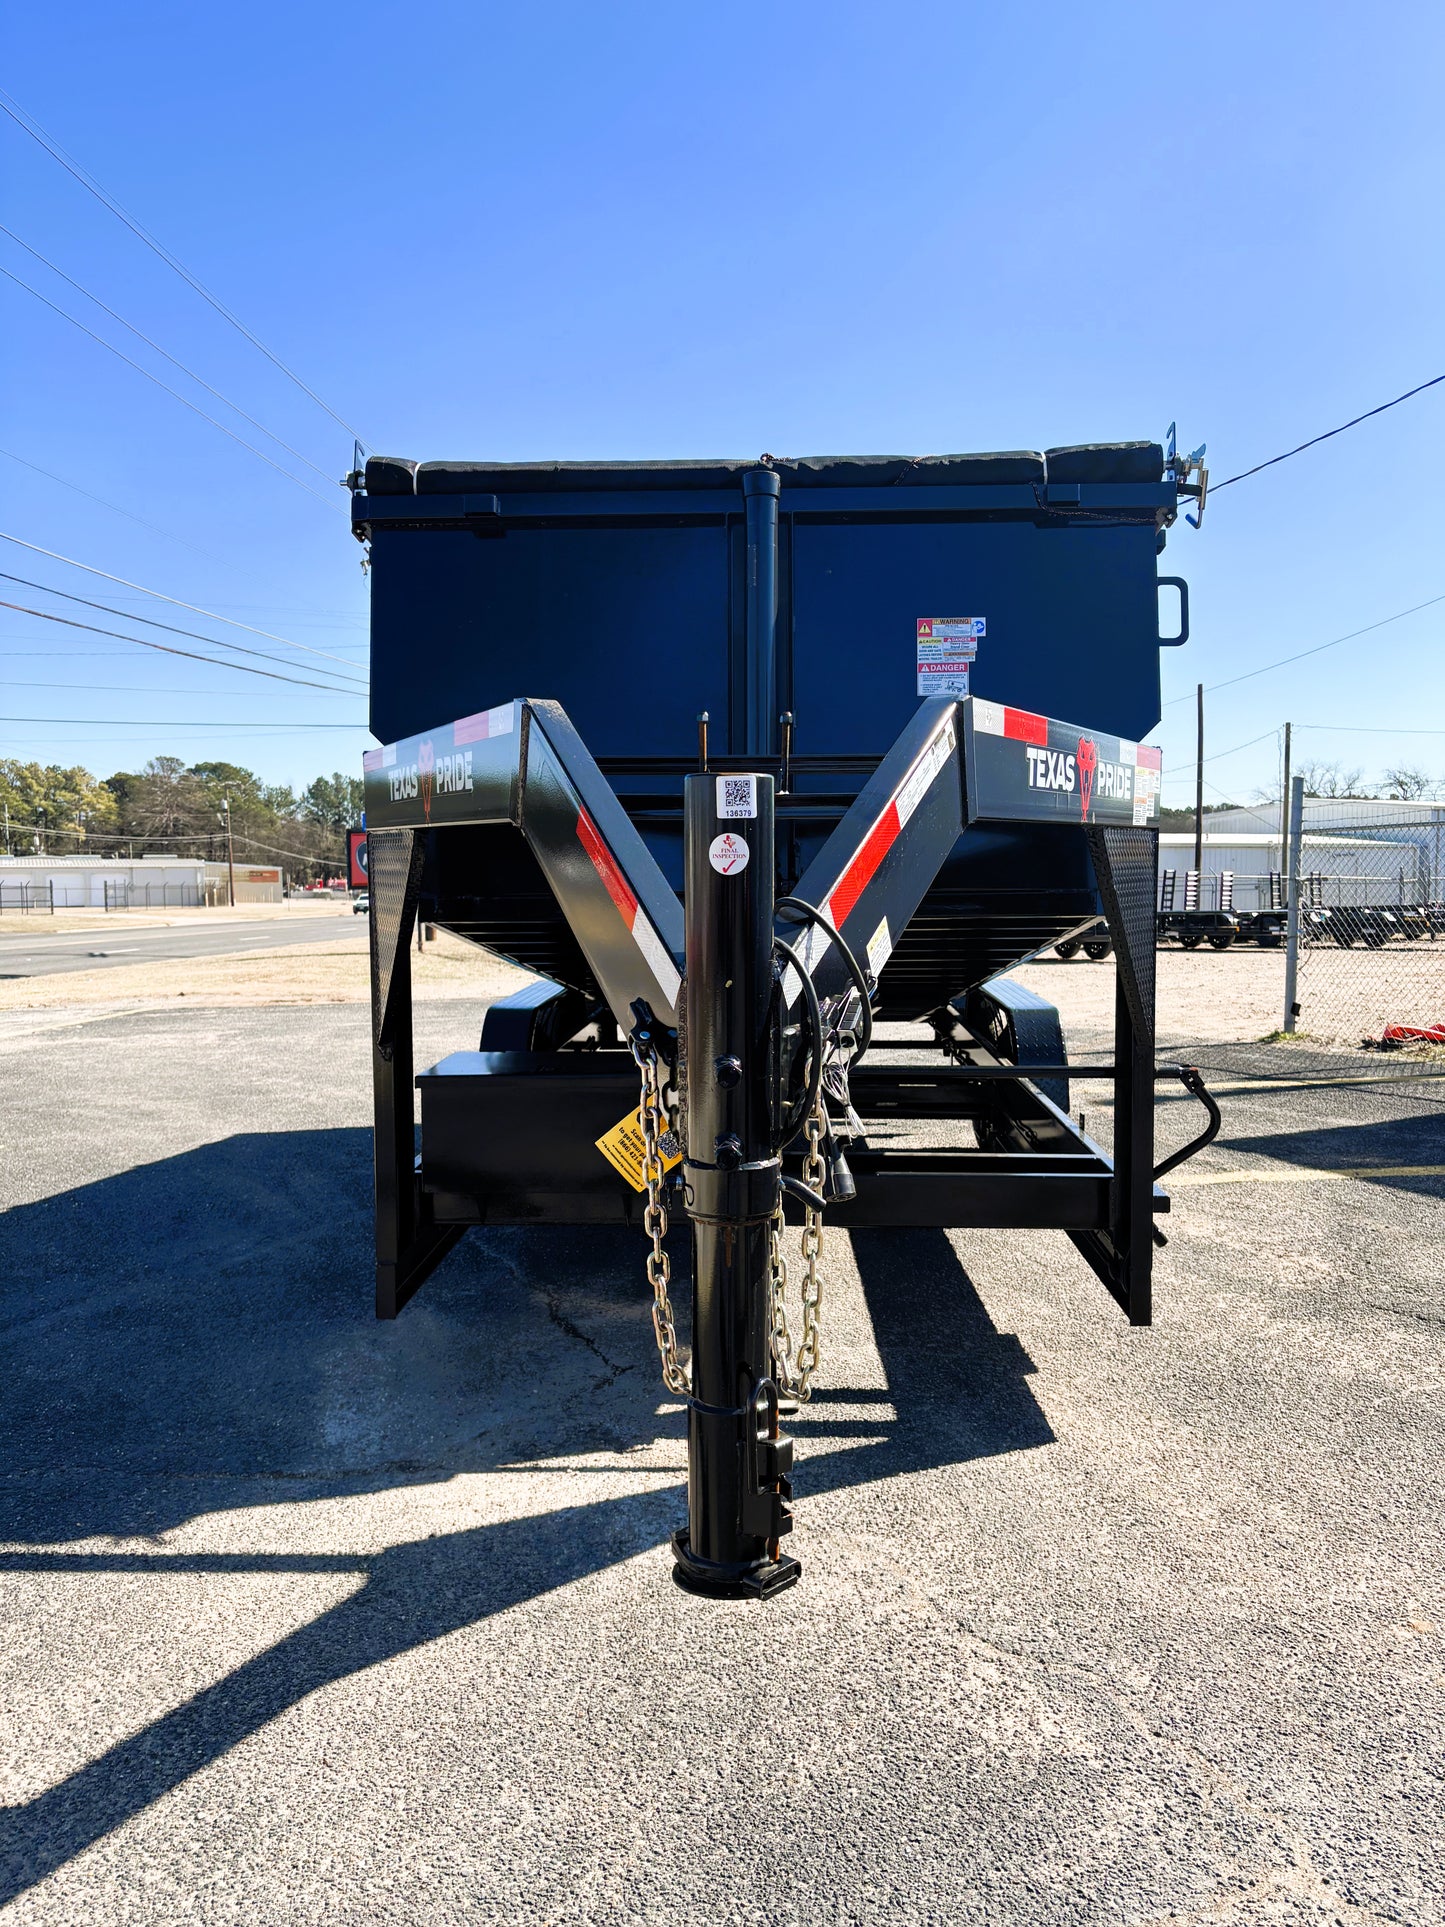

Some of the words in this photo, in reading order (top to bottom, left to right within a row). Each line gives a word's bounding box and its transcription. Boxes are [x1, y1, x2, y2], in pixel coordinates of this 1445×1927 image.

[388, 764, 418, 801] TEXAS
[436, 751, 473, 794] PRIDE
[1027, 747, 1075, 792] TEXAS
[1097, 762, 1131, 800] PRIDE
[726, 809, 752, 817] 136379
[623, 1133, 632, 1142] get
[631, 1142, 641, 1153] your
[631, 1129, 642, 1141] Scan
[618, 1138, 630, 1153] (866)
